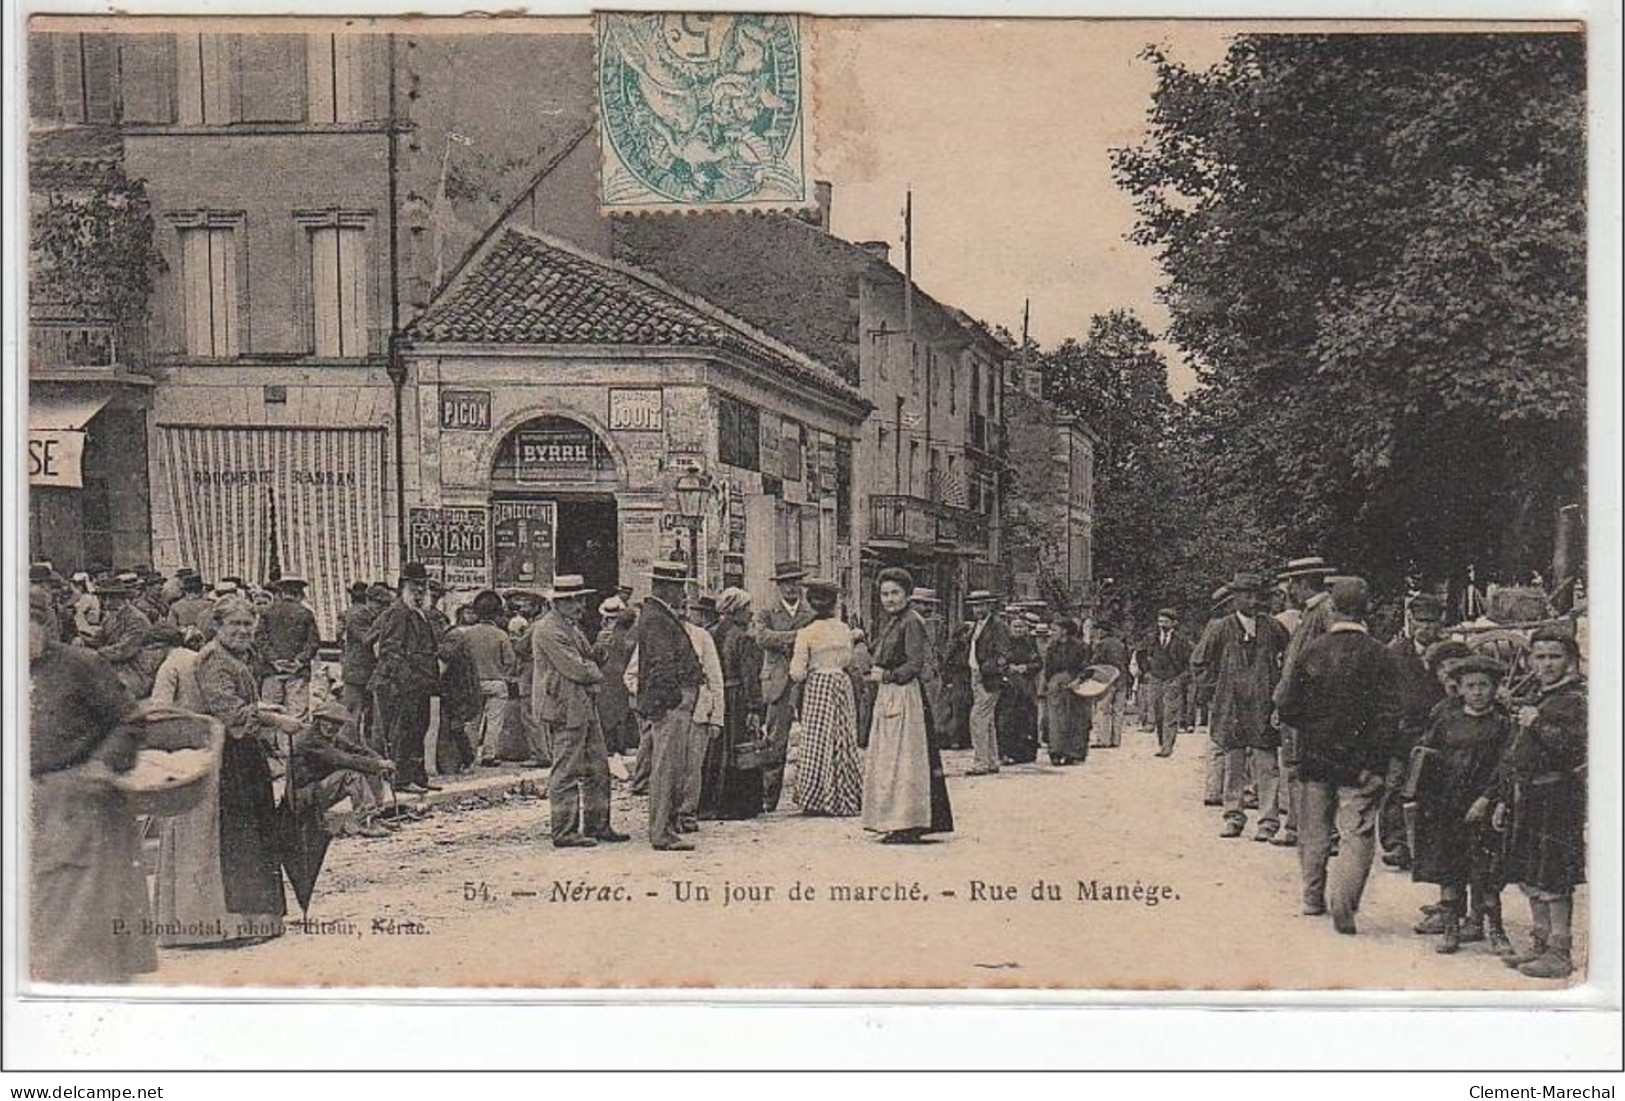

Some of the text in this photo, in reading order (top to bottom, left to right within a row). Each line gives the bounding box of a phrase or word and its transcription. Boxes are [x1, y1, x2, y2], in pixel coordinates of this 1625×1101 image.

[444, 402, 487, 426] PICON
[28, 440, 59, 476] SE
[524, 445, 588, 462] BYRRH
